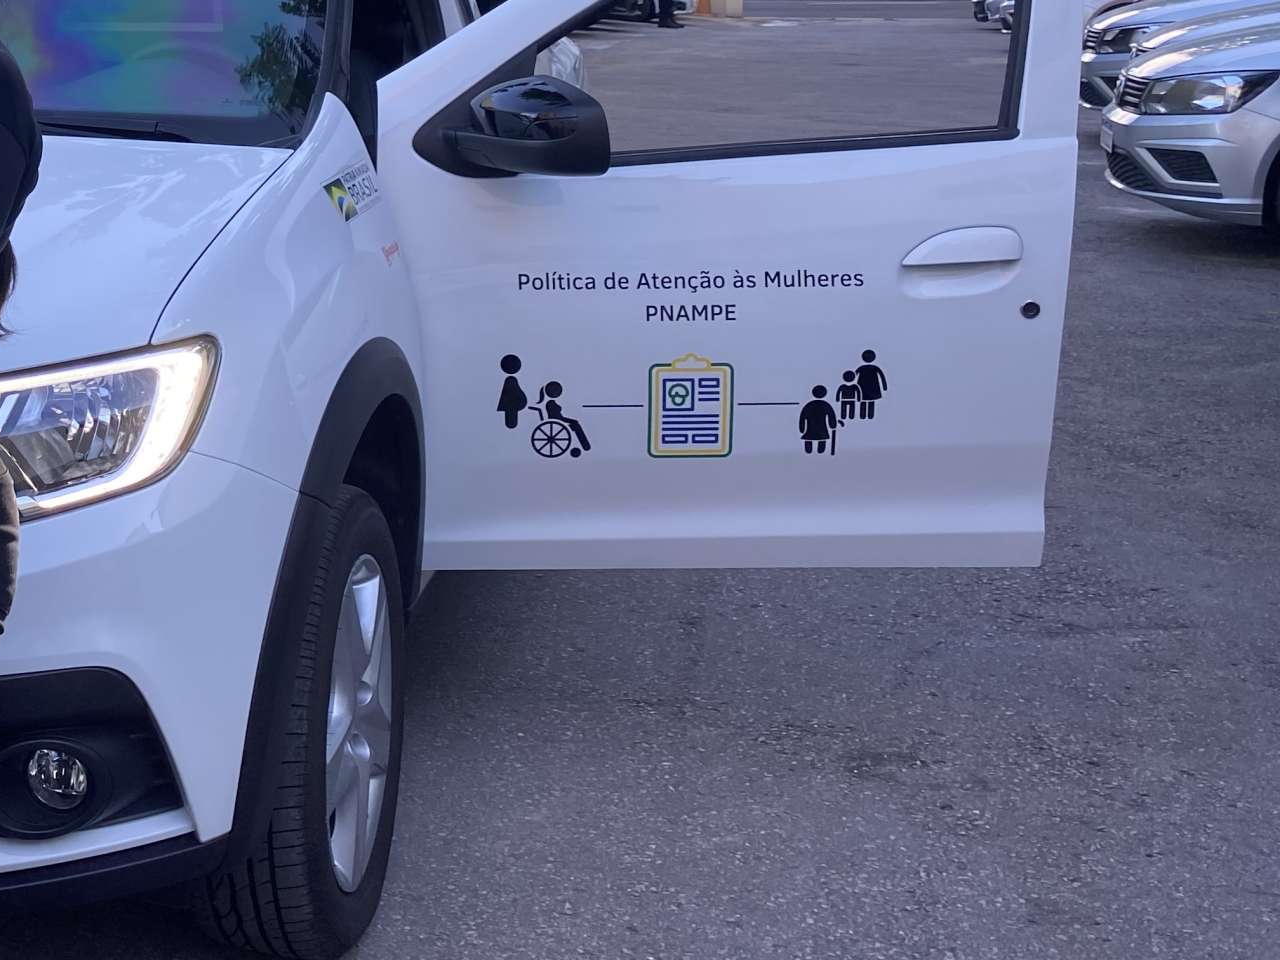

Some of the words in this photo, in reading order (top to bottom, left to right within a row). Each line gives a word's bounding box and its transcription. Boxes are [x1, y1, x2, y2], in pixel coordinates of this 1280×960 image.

[347, 174, 379, 205] BRASIL
[517, 271, 596, 291] Política
[604, 271, 630, 290] de
[636, 270, 726, 293] Atenção
[732, 269, 757, 289] às
[764, 269, 865, 288] Mulheres
[645, 304, 737, 322] PNAMPE
